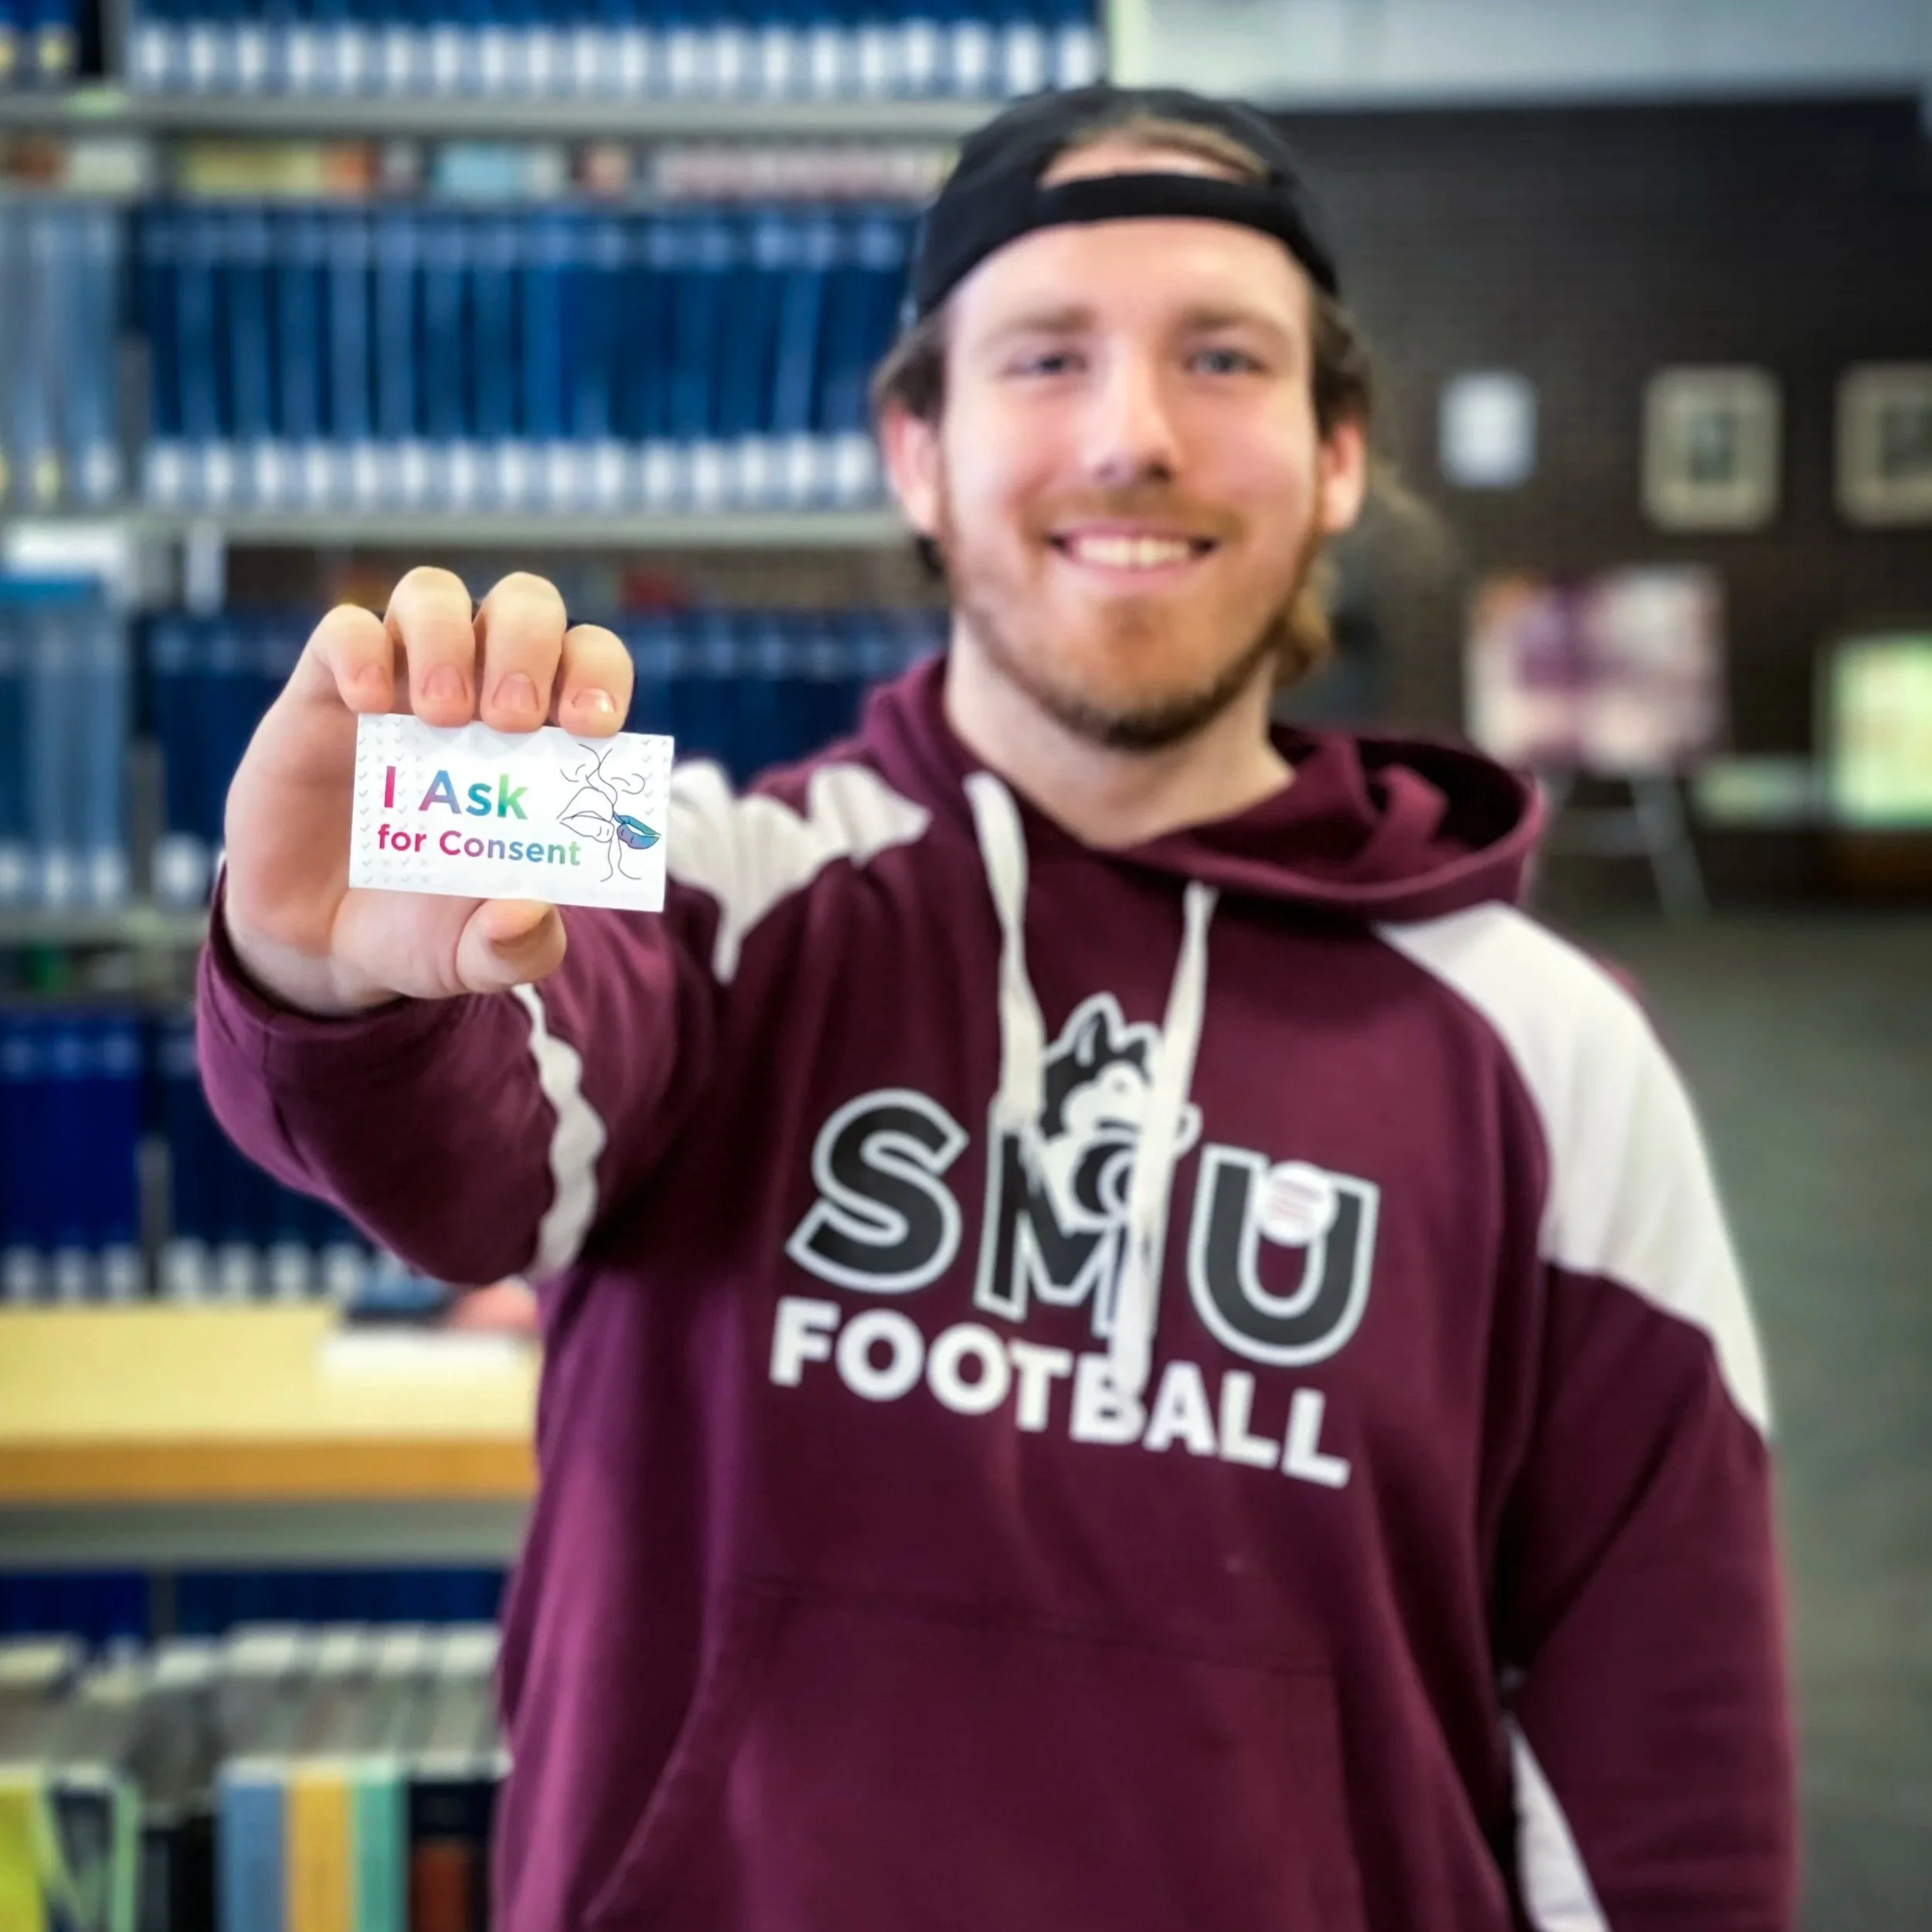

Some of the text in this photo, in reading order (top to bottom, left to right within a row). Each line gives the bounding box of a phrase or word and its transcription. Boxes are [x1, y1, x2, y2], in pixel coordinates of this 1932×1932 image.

[378, 824, 580, 866] for Consent
[383, 765, 529, 820] I Ask
[785, 1088, 1379, 1367] SMU
[770, 1295, 1350, 1488] FOOTBALL
